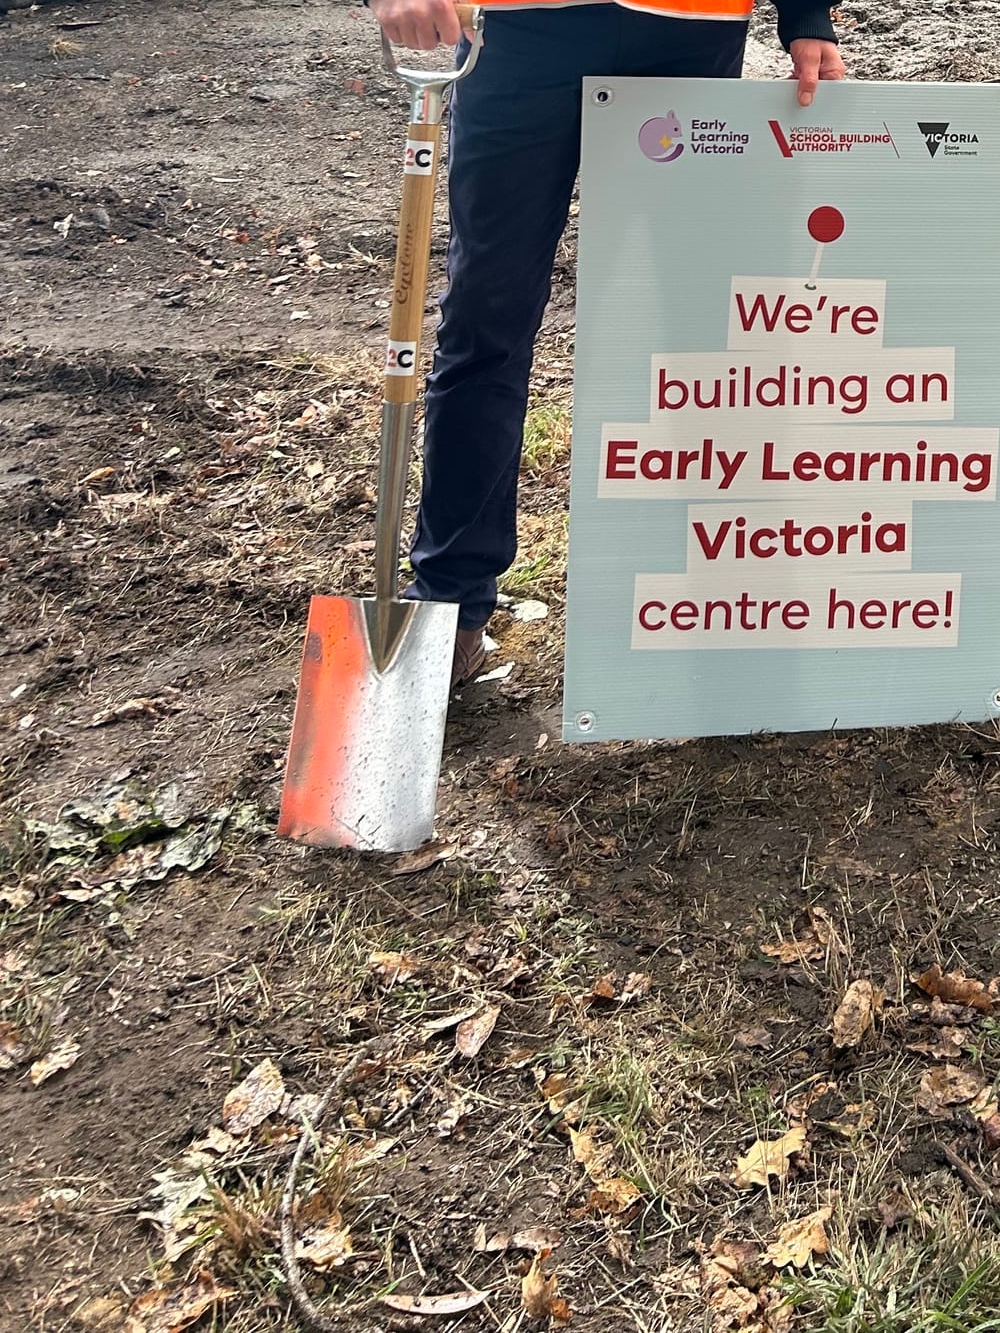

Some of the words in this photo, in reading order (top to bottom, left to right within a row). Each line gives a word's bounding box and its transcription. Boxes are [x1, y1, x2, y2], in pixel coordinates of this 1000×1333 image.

[691, 119, 727, 132] Early
[789, 126, 833, 134] VICTORIAN
[690, 131, 750, 145] Learning
[789, 134, 836, 143] SCHOOL
[839, 134, 891, 144] BUILDING
[922, 133, 979, 143] VICTORIA
[690, 143, 745, 155] Victoria
[789, 143, 853, 153] AUTHORITY
[405, 148, 433, 168] 2C
[735, 293, 880, 335] We’re
[387, 348, 413, 368] 2C
[657, 365, 869, 415] building
[885, 372, 948, 403] an
[605, 438, 748, 490] Early
[762, 440, 992, 493] Learning
[692, 511, 907, 561] Victoria
[638, 592, 810, 632] centre
[827, 588, 953, 631] here!
